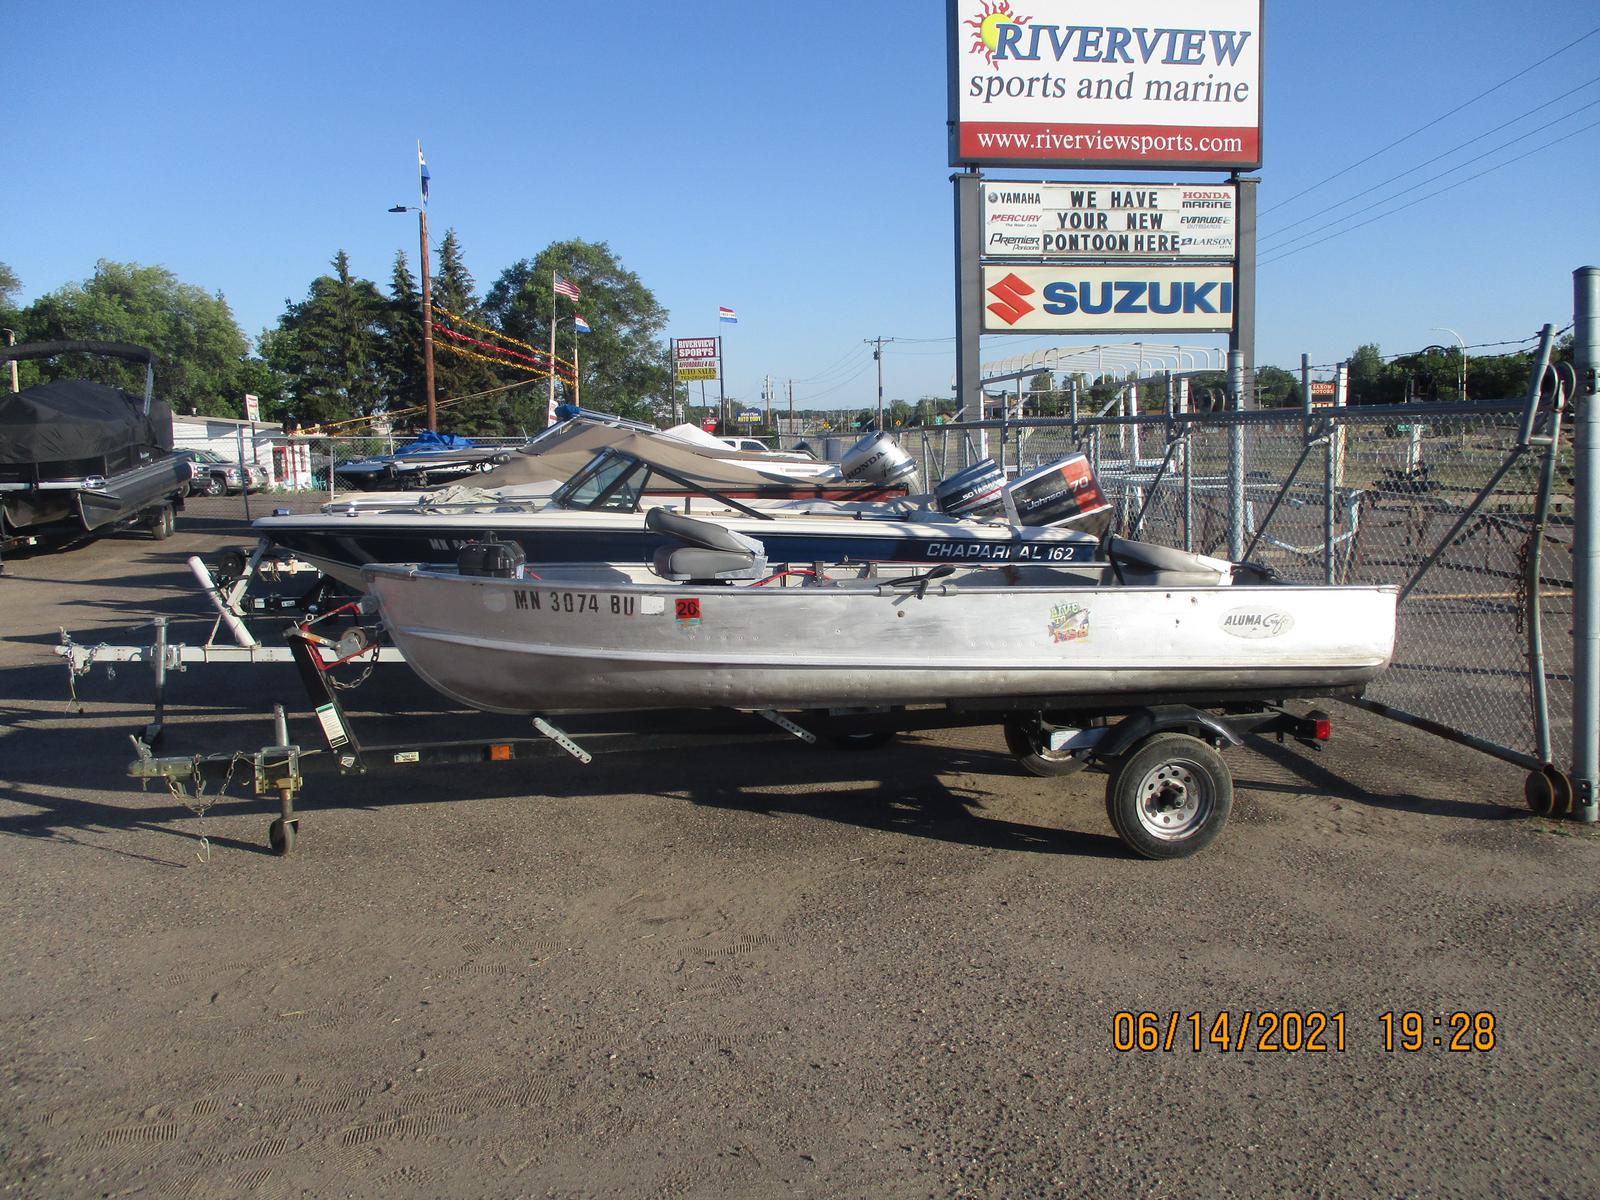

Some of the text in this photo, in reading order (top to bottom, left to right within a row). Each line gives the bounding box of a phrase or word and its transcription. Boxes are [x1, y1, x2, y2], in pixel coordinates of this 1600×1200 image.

[992, 23, 1251, 66] RIVERVIEW
[969, 72, 1249, 103] sports and marine
[977, 129, 1242, 154] www.riverviewsports.com
[1000, 192, 1041, 204] YAMAHA
[1070, 191, 1158, 208] WE HAVE
[1182, 191, 1231, 199] HONDA
[991, 214, 1042, 222] MERCURY
[1057, 212, 1163, 230] YOUR NEW
[1180, 216, 1223, 224] EVINRUDE
[1043, 234, 1180, 251] PONTOON HERE
[1193, 238, 1233, 246] LARSON
[1042, 281, 1232, 315] SUZUKI
[678, 340, 715, 348] RIVERVIEW
[679, 348, 714, 357] SPORTS
[697, 367, 717, 375] SALES
[847, 452, 887, 479] HONDA
[1070, 476, 1089, 492] 70
[963, 490, 975, 501] 50
[1027, 489, 1067, 510] Johnson
[1048, 547, 1075, 560] 162
[513, 590, 635, 616] MN 3074 BU
[676, 601, 698, 616] 20
[1224, 614, 1262, 626] ALUMA
